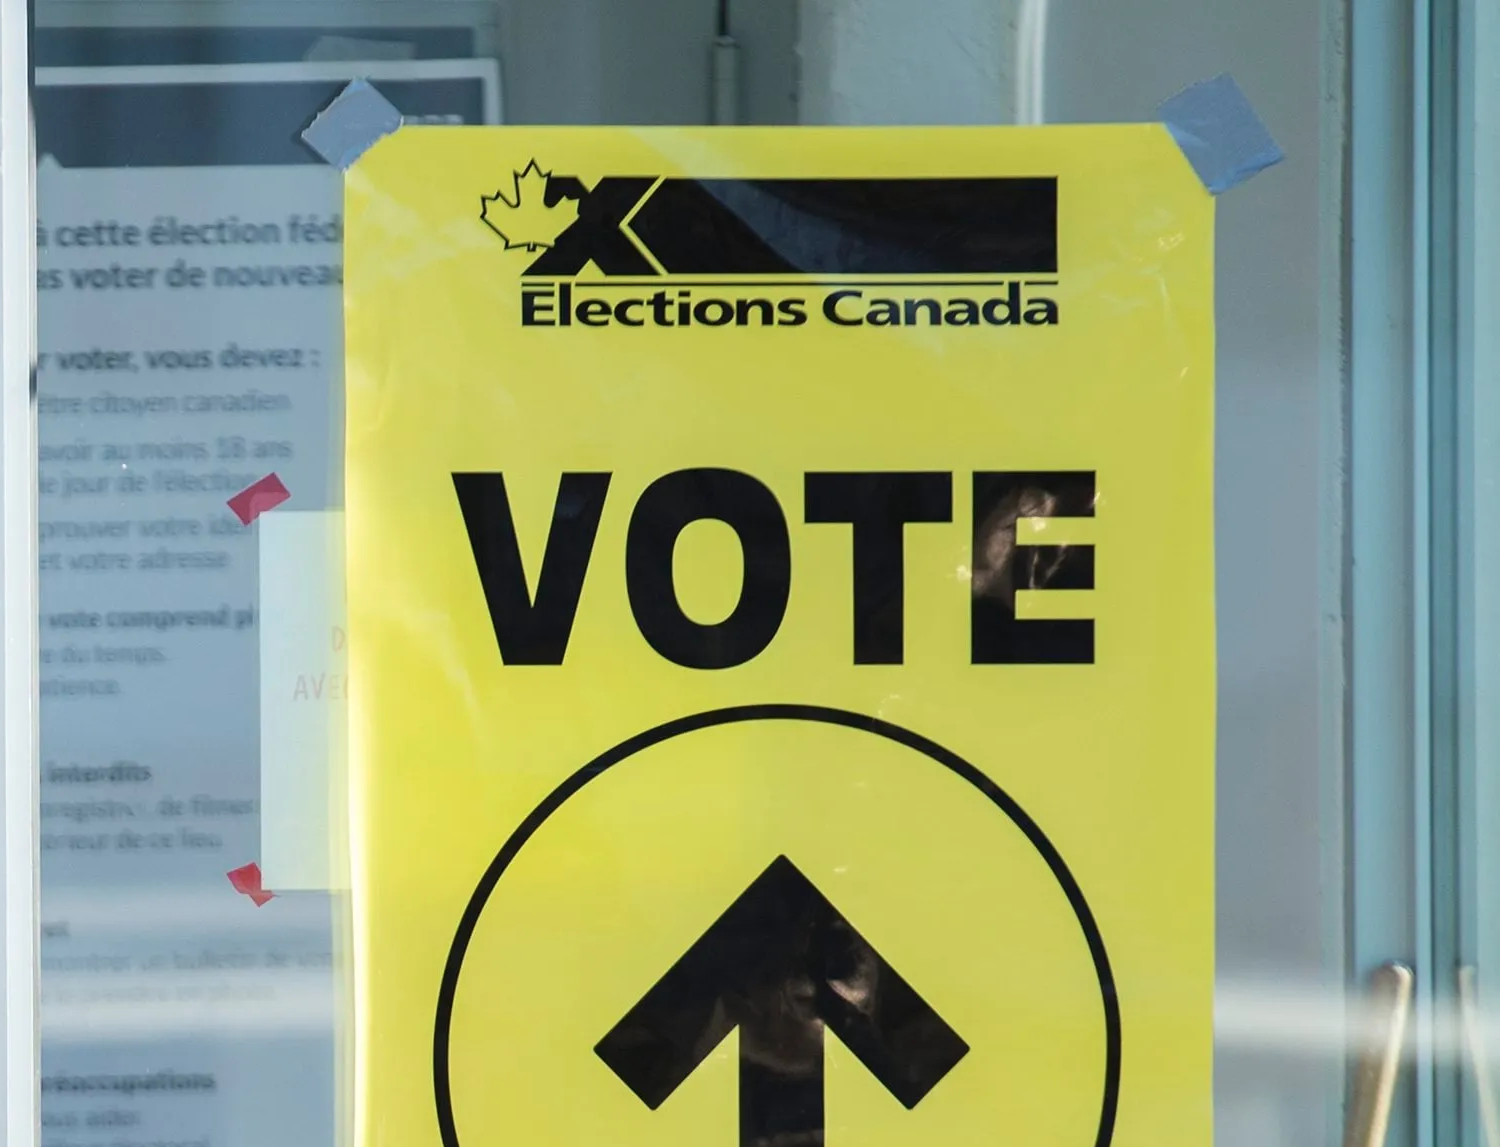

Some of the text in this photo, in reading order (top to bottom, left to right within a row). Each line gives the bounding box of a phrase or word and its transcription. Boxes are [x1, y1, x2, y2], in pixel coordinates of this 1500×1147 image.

[56, 219, 141, 247] cette
[148, 214, 280, 246] élection
[70, 260, 157, 289] voter
[166, 258, 205, 287] de
[823, 283, 1058, 326] Canada
[145, 350, 212, 370] vous
[218, 342, 304, 369] devez
[451, 467, 1098, 670] VOTE
